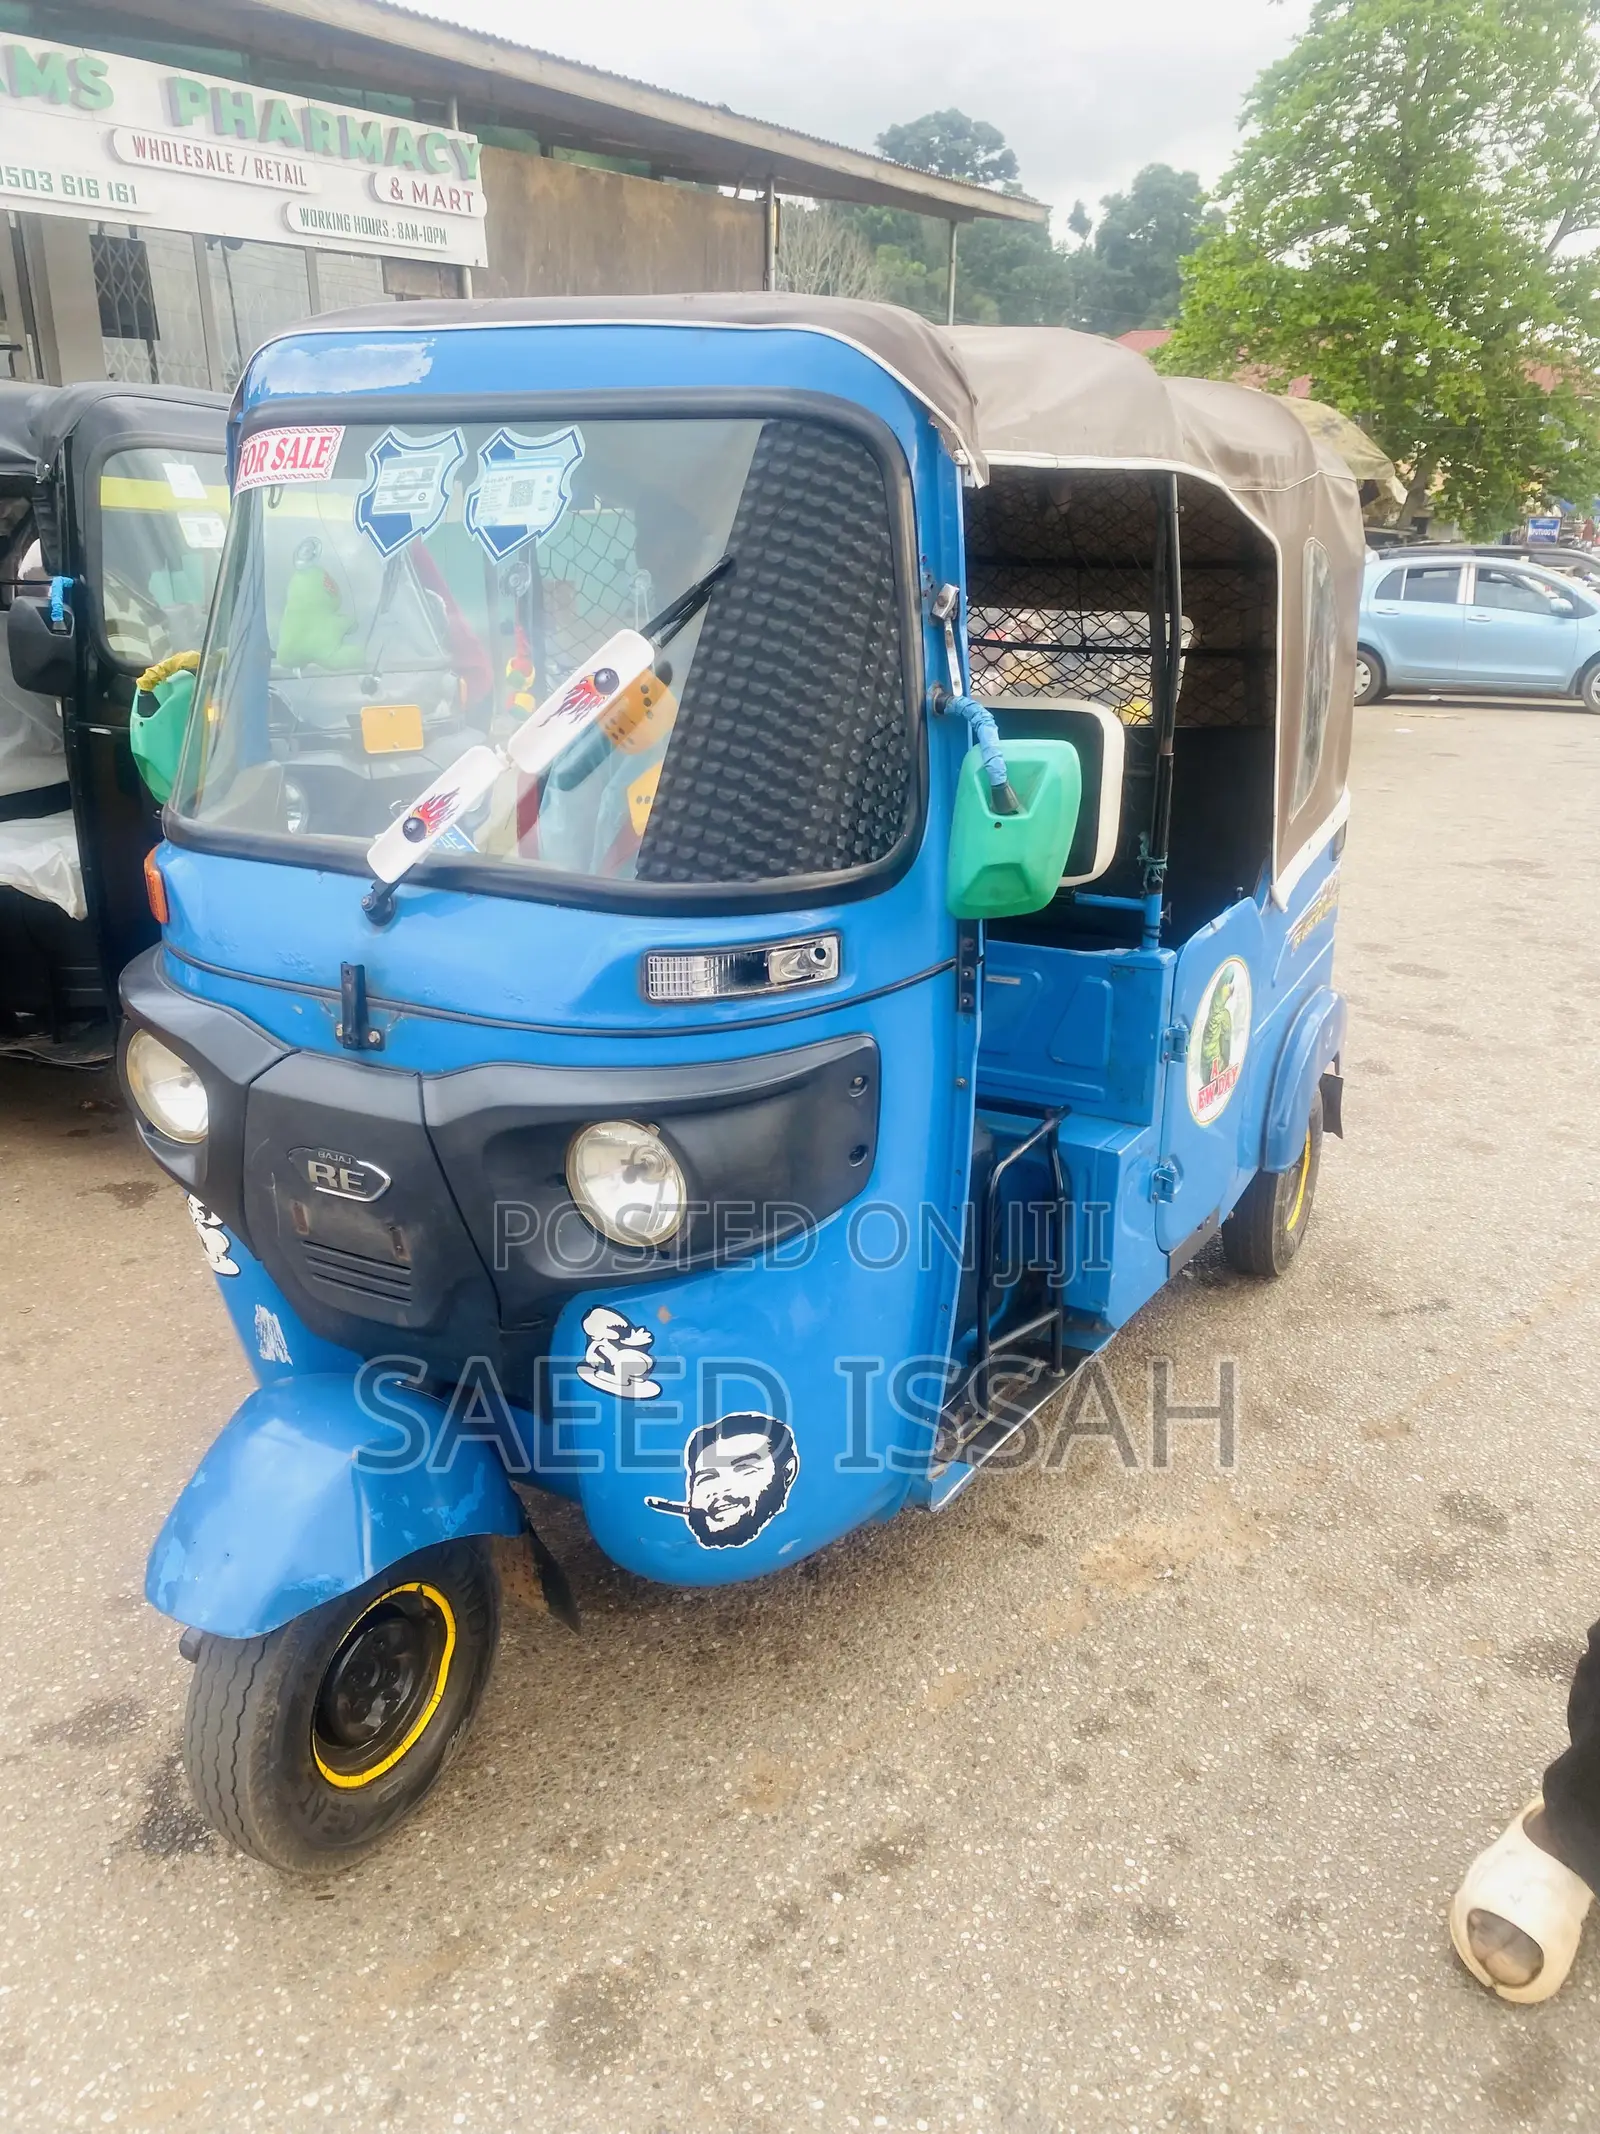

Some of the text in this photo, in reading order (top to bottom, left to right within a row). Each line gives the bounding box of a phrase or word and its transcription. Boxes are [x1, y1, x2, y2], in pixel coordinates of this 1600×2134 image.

[0, 44, 483, 181] MS PHARMACY
[132, 134, 235, 175] WHOLESALE
[254, 157, 308, 188] RETAIL
[61, 174, 100, 200] 616
[107, 181, 138, 205] 161
[390, 176, 474, 213] & MART
[299, 207, 352, 233] WORKING
[353, 214, 389, 238] HOURS
[397, 221, 448, 246] 8AM-10PM
[239, 436, 333, 477] FOR SALE
[318, 1151, 353, 1165] BAJAJ
[308, 1160, 367, 1195] RE
